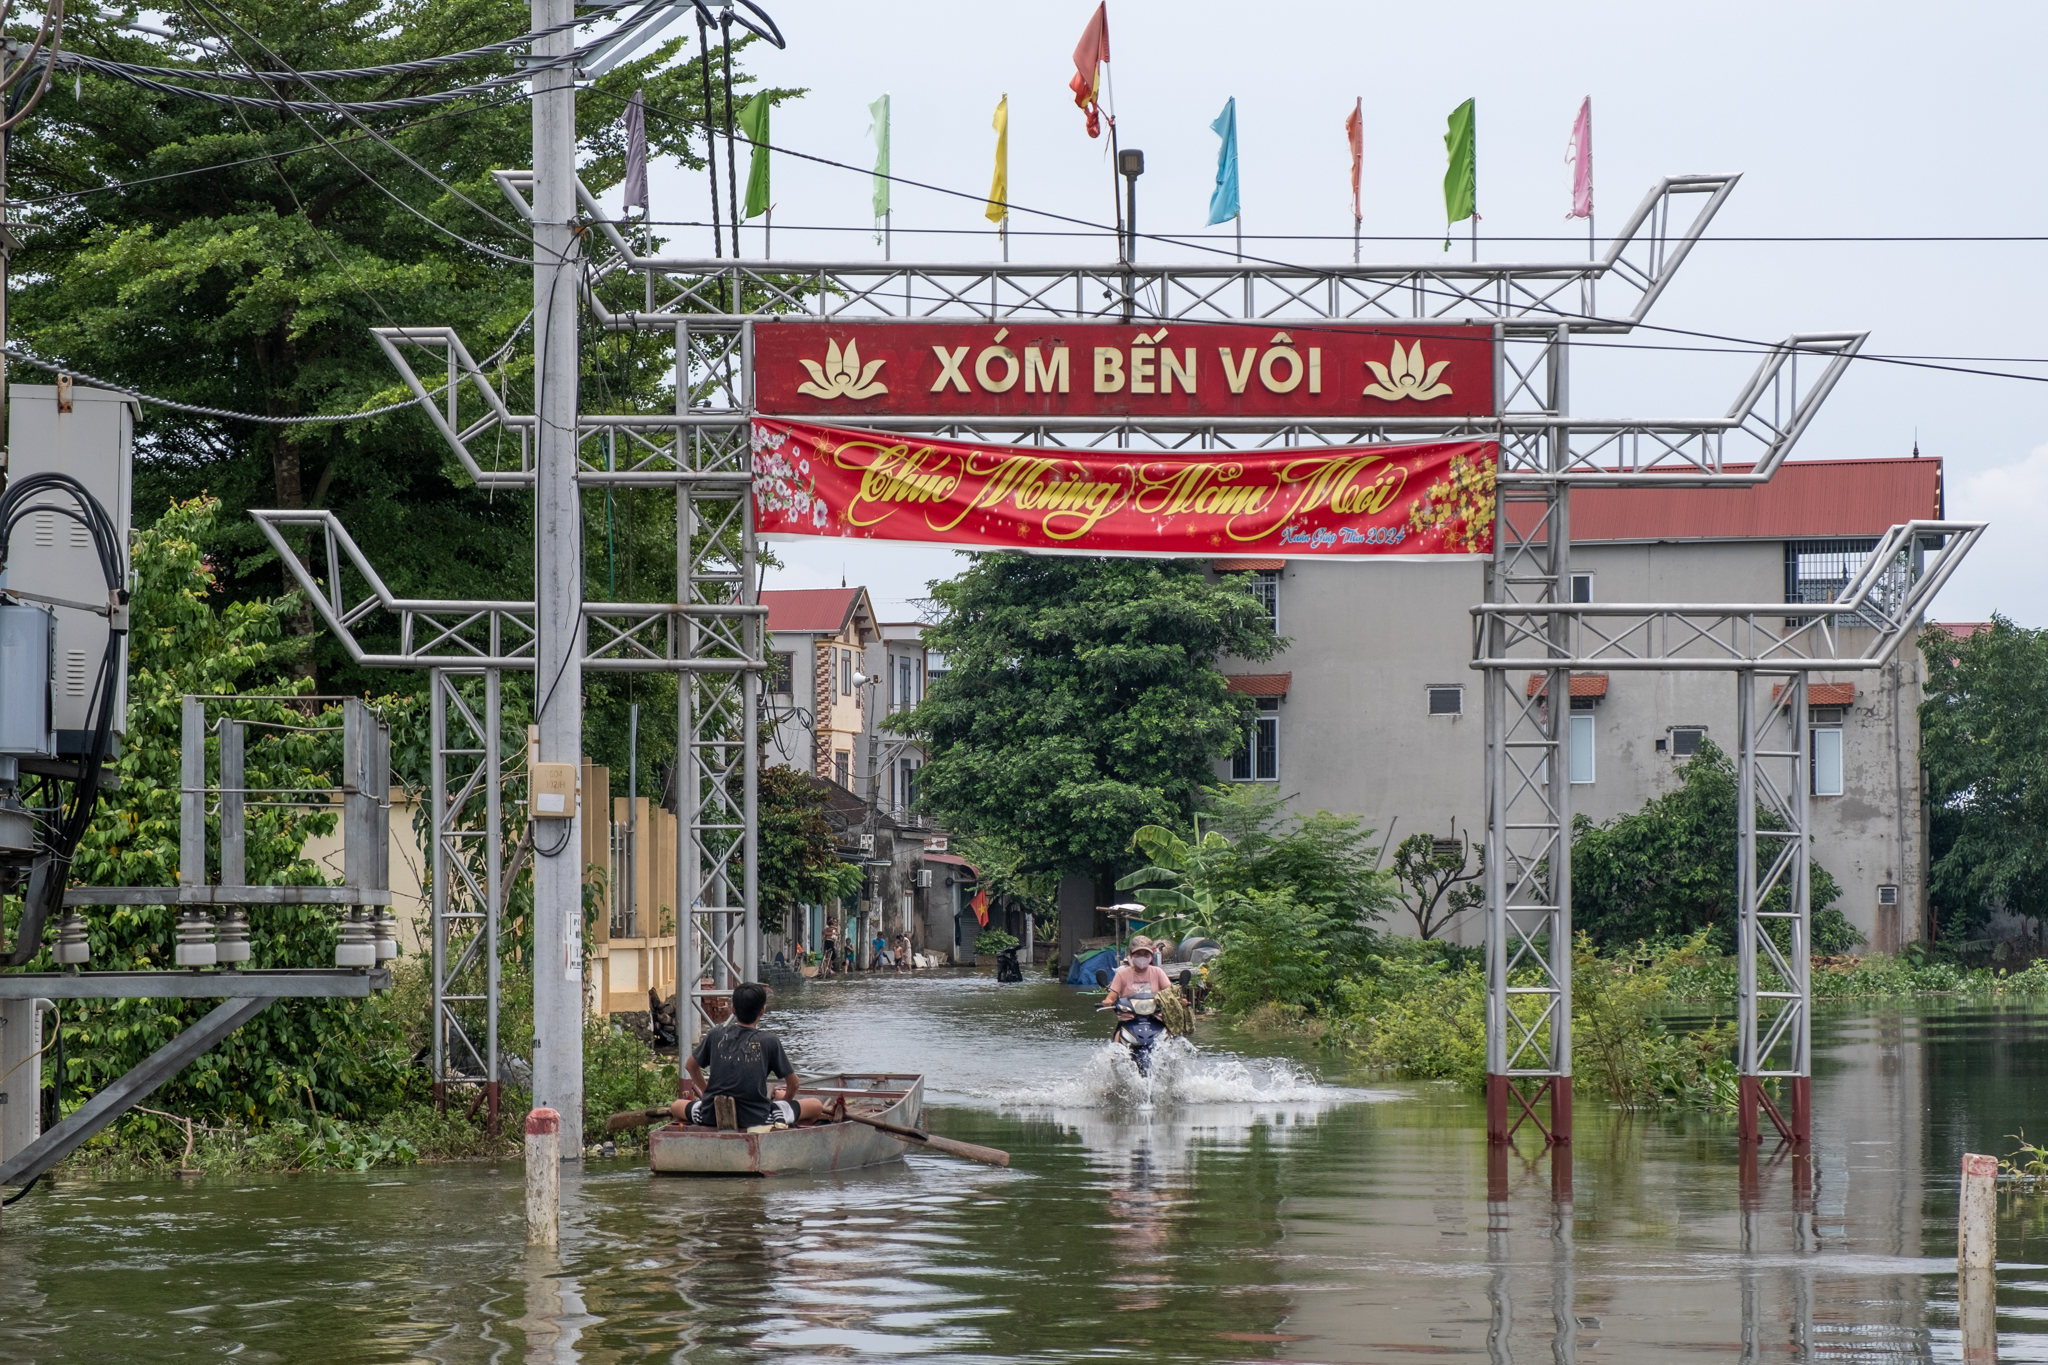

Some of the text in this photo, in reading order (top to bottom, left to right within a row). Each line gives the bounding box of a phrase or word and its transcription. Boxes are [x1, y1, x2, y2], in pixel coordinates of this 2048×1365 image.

[930, 327, 1322, 394] XÓM BẾN VÔI
[833, 441, 1408, 542] Chúc Mừng Năm Mới
[1365, 524, 1406, 545] 2024
